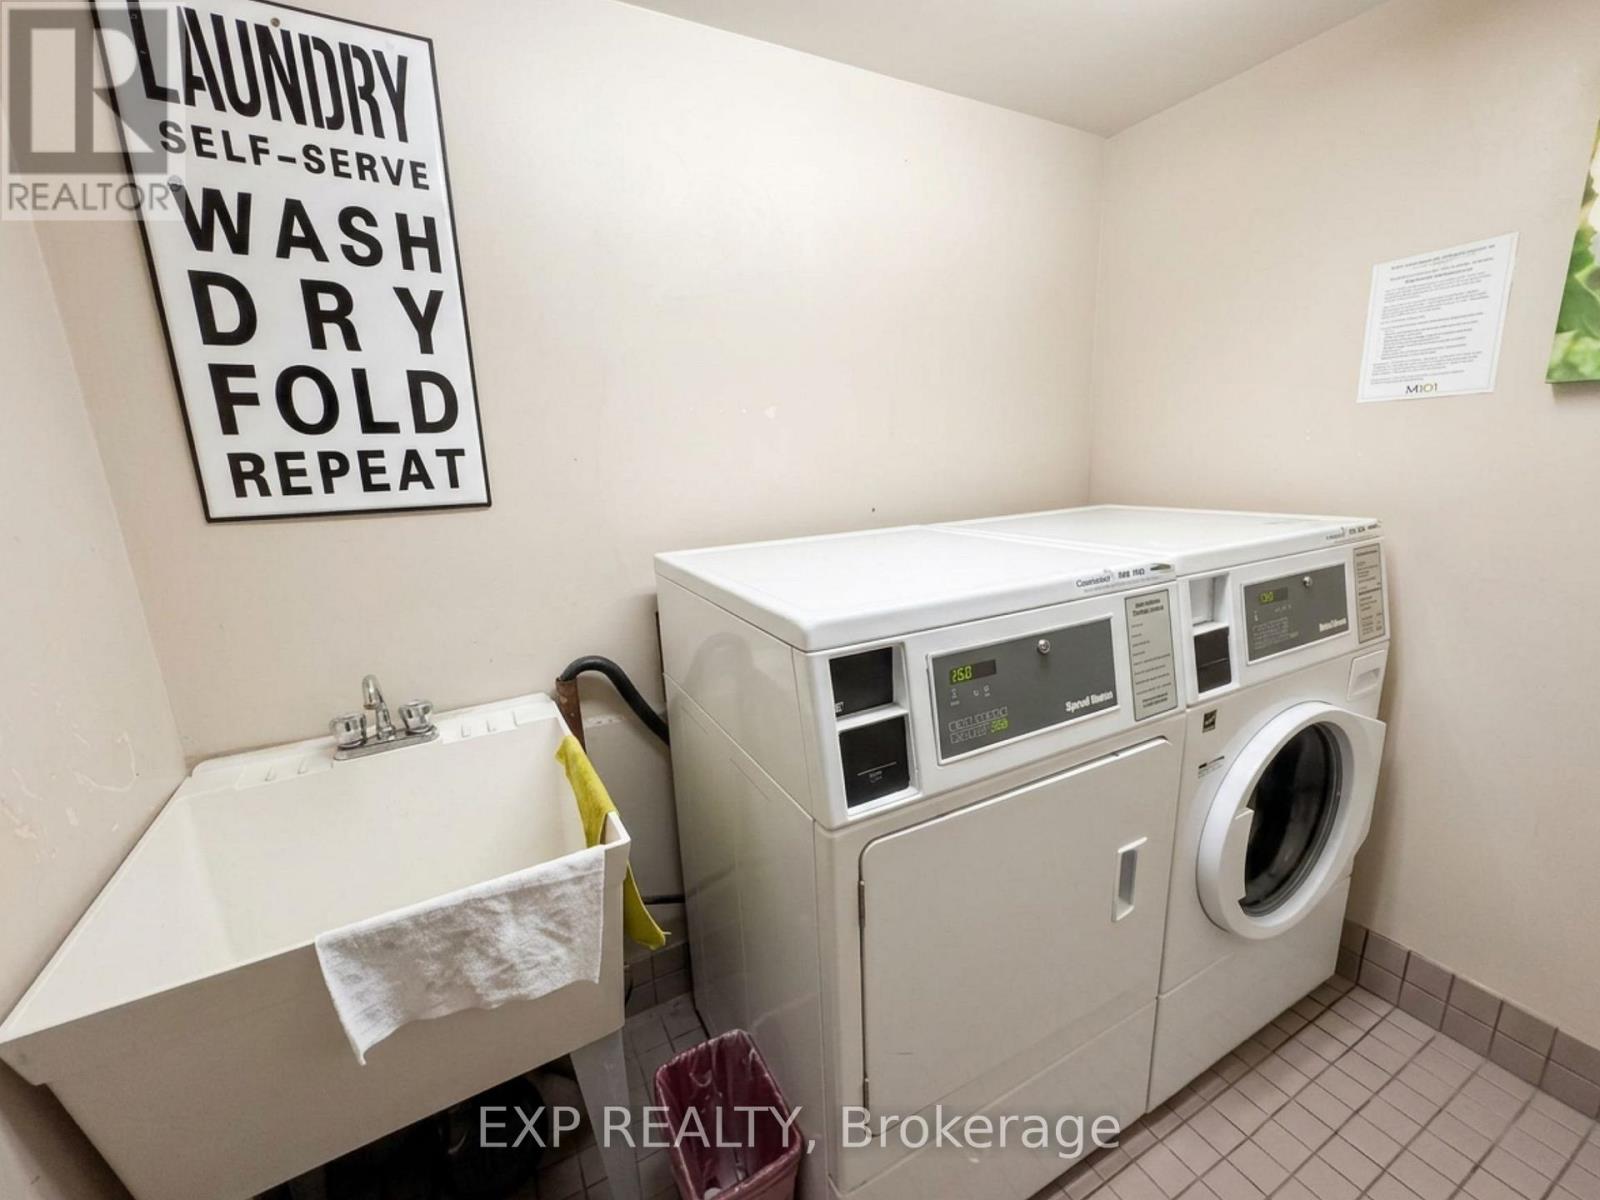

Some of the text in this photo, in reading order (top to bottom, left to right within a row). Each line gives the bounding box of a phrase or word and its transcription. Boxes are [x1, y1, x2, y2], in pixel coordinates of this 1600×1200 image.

[126, 0, 408, 143] LAUNDRY
[159, 121, 430, 190] SELF-SERVE
[168, 183, 443, 274] WASH
[187, 268, 444, 355] DRY
[208, 363, 460, 436] FOLD
[227, 448, 466, 499] REPEAT
